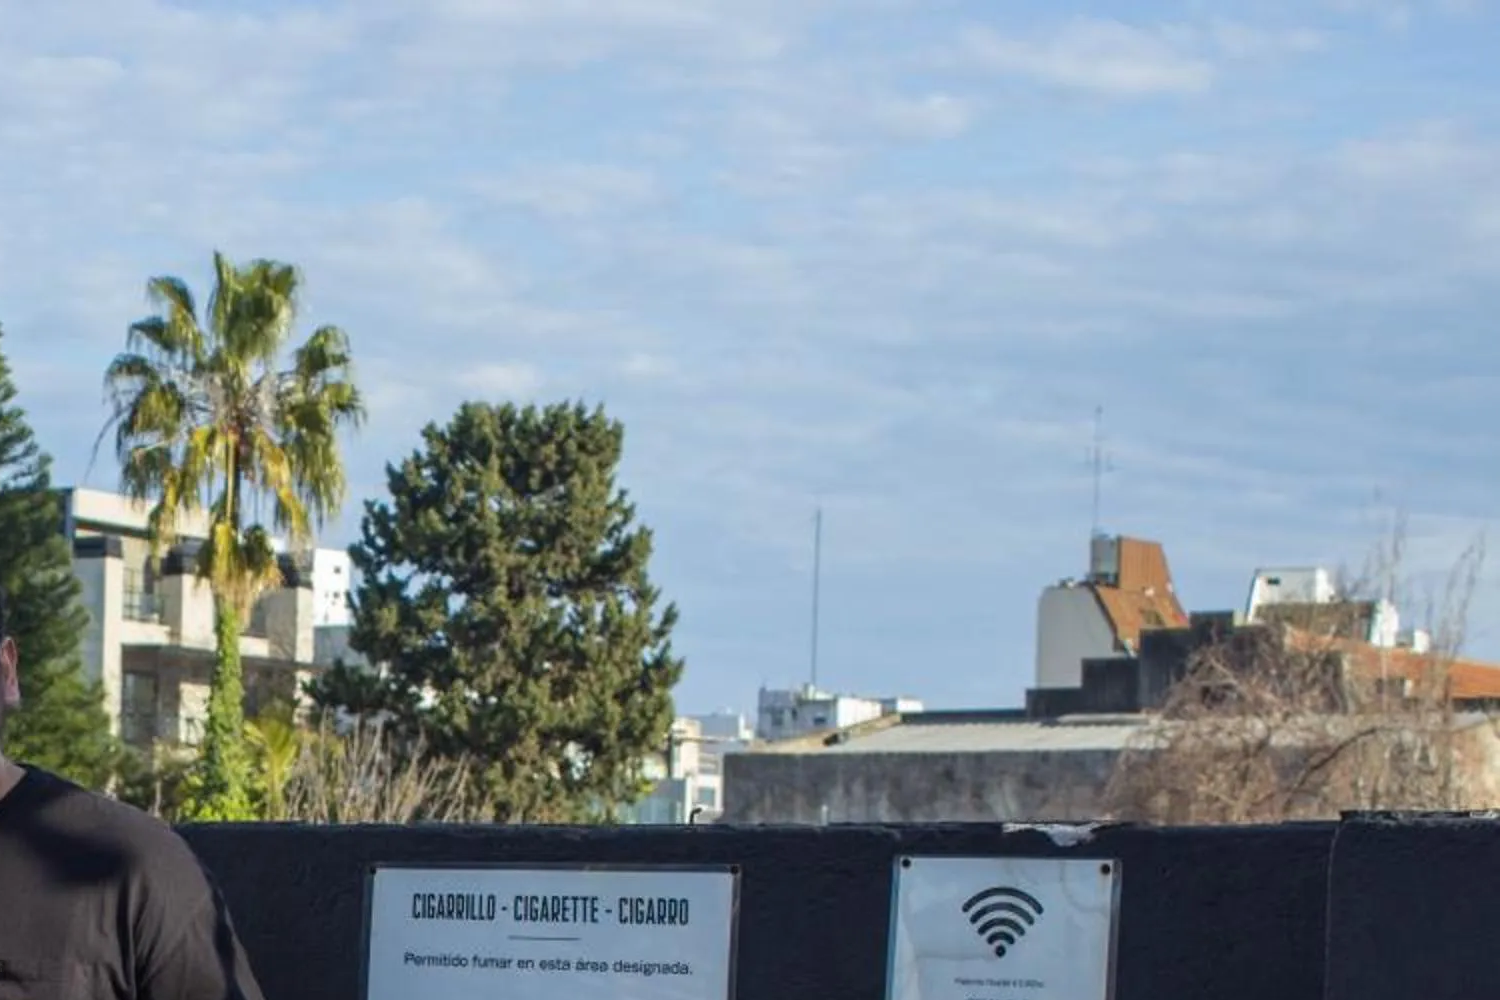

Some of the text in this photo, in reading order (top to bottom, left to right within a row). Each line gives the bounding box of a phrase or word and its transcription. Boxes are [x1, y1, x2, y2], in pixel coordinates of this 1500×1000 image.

[412, 893, 496, 921] CIGARRILLO
[514, 895, 599, 923] CIGARETTE
[619, 897, 689, 925] CIGARRO
[404, 952, 468, 968] Permitido
[472, 955, 512, 969] fumar
[517, 959, 534, 969] en
[539, 958, 571, 971] esta
[613, 959, 693, 976] designada.
